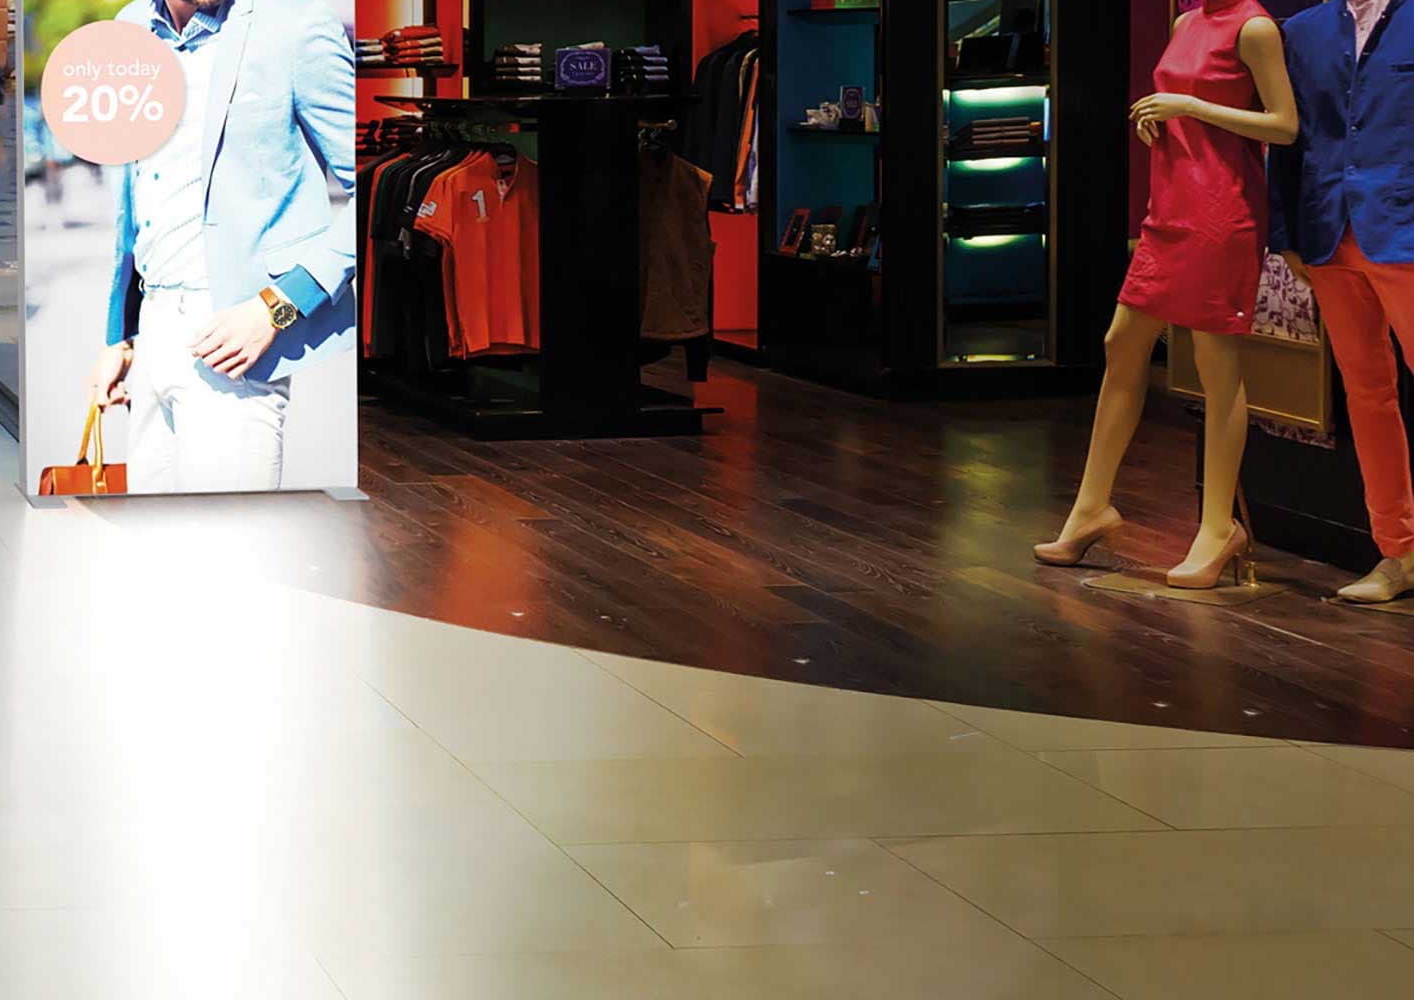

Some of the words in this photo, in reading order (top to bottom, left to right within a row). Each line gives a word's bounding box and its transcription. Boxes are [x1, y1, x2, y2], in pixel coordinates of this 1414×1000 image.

[63, 60, 101, 80] only
[108, 60, 161, 80] today
[570, 61, 597, 71] SALE
[62, 84, 164, 122] 20%
[472, 190, 487, 219] 1
